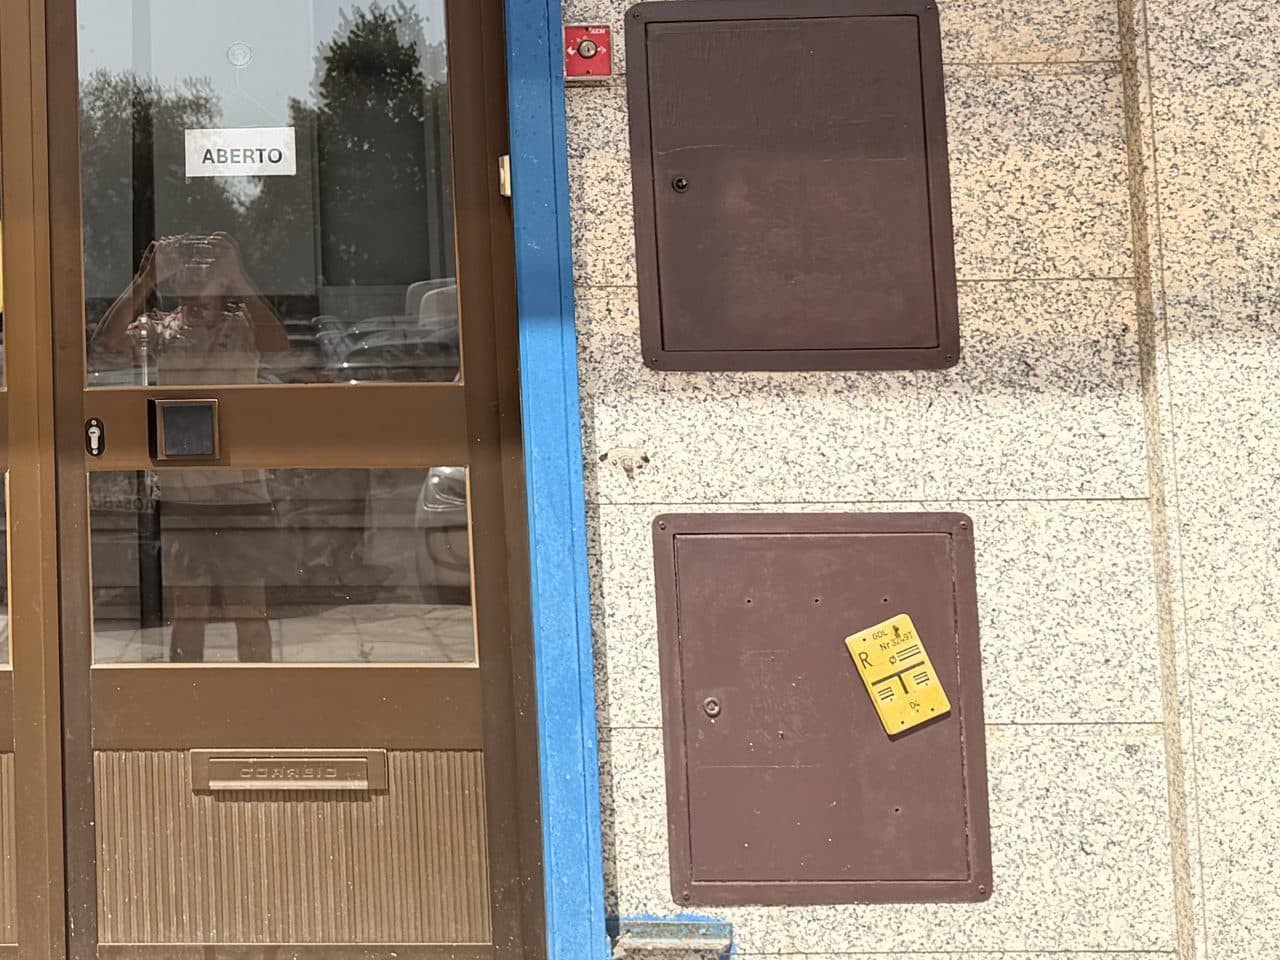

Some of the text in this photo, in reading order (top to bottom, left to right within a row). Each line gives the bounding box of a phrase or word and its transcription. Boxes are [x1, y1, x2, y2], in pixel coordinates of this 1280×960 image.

[202, 148, 283, 164] ABERTO
[858, 652, 873, 669] R
[240, 766, 337, 778] CORREIO
